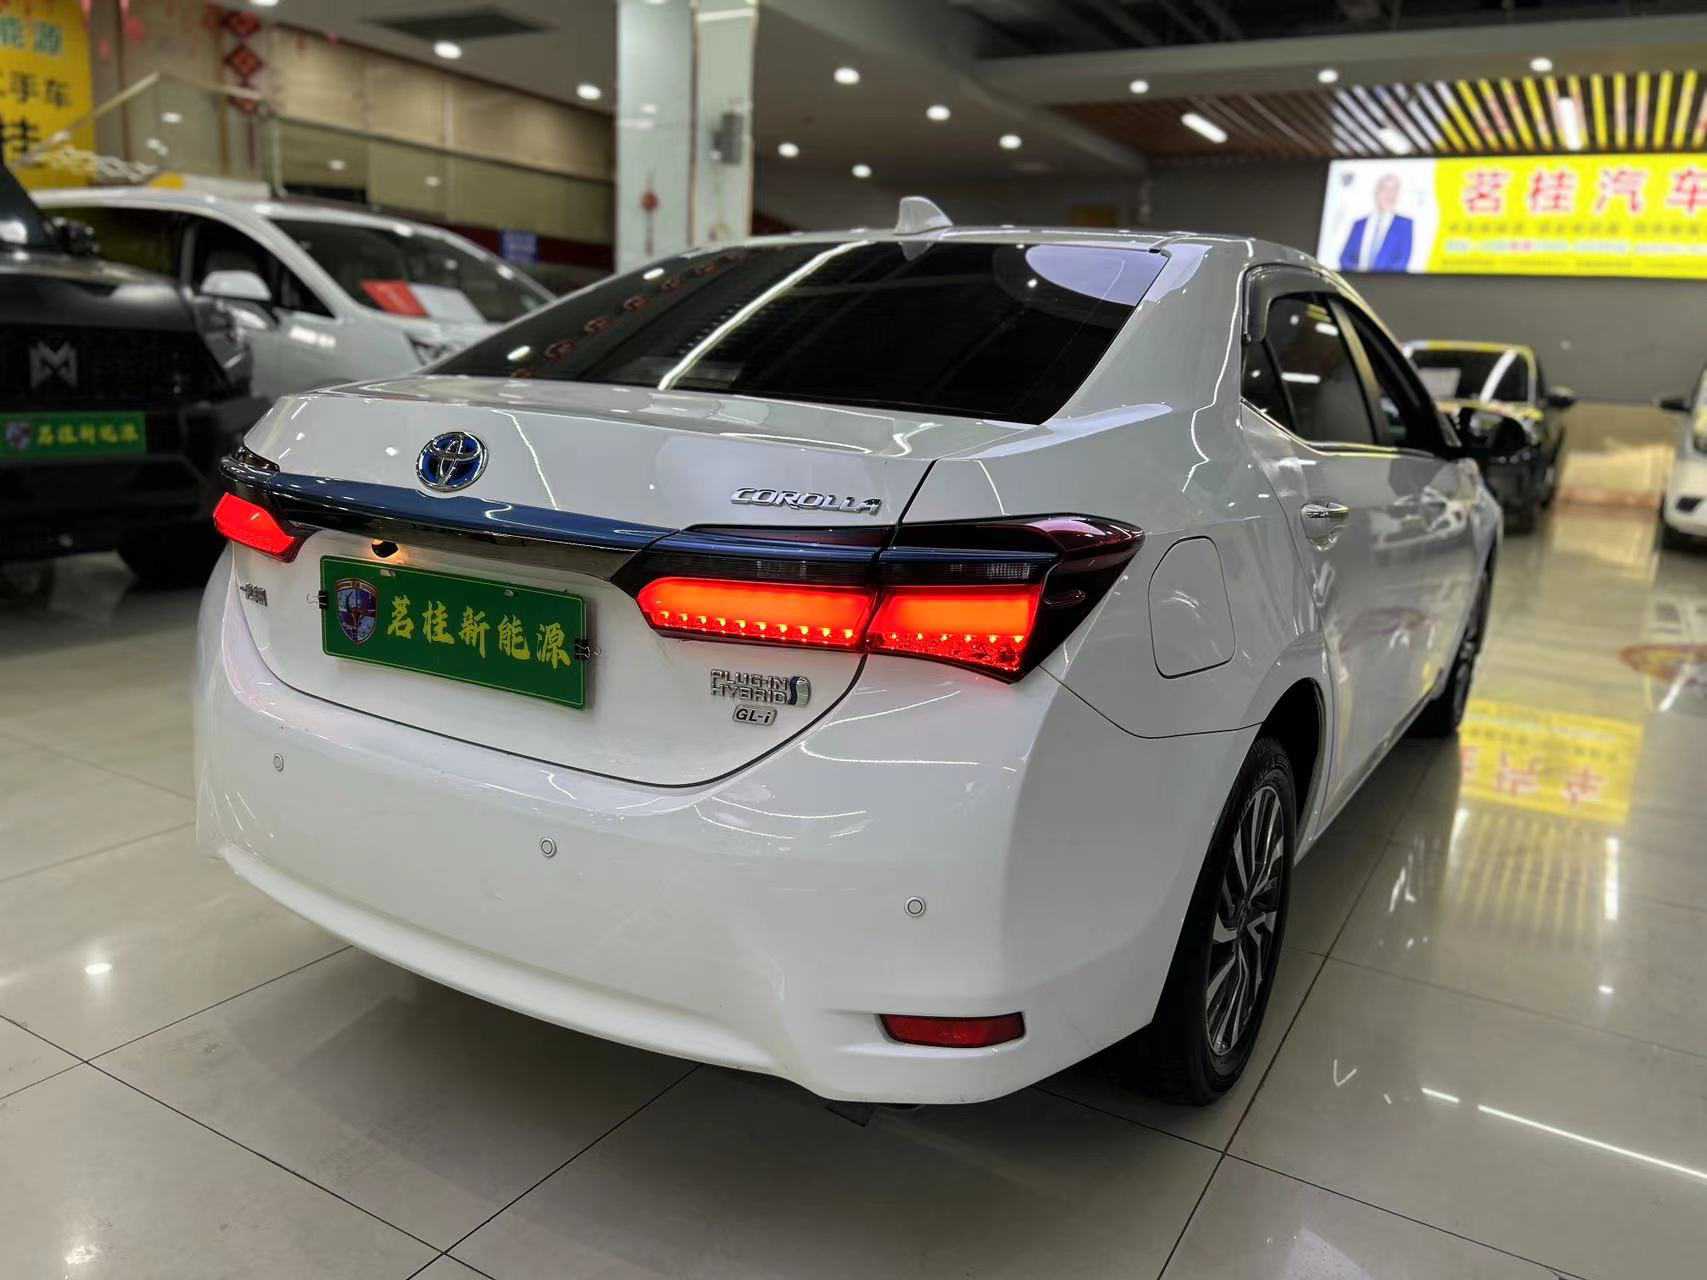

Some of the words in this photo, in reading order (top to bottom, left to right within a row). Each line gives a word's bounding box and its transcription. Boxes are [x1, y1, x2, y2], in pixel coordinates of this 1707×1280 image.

[1464, 169, 1707, 215] 茗桂汽车
[730, 487, 882, 515] COROLLA
[386, 594, 572, 669] 茗桂新能源
[710, 684, 788, 706] HYBRID
[735, 708, 772, 725] GL-i
